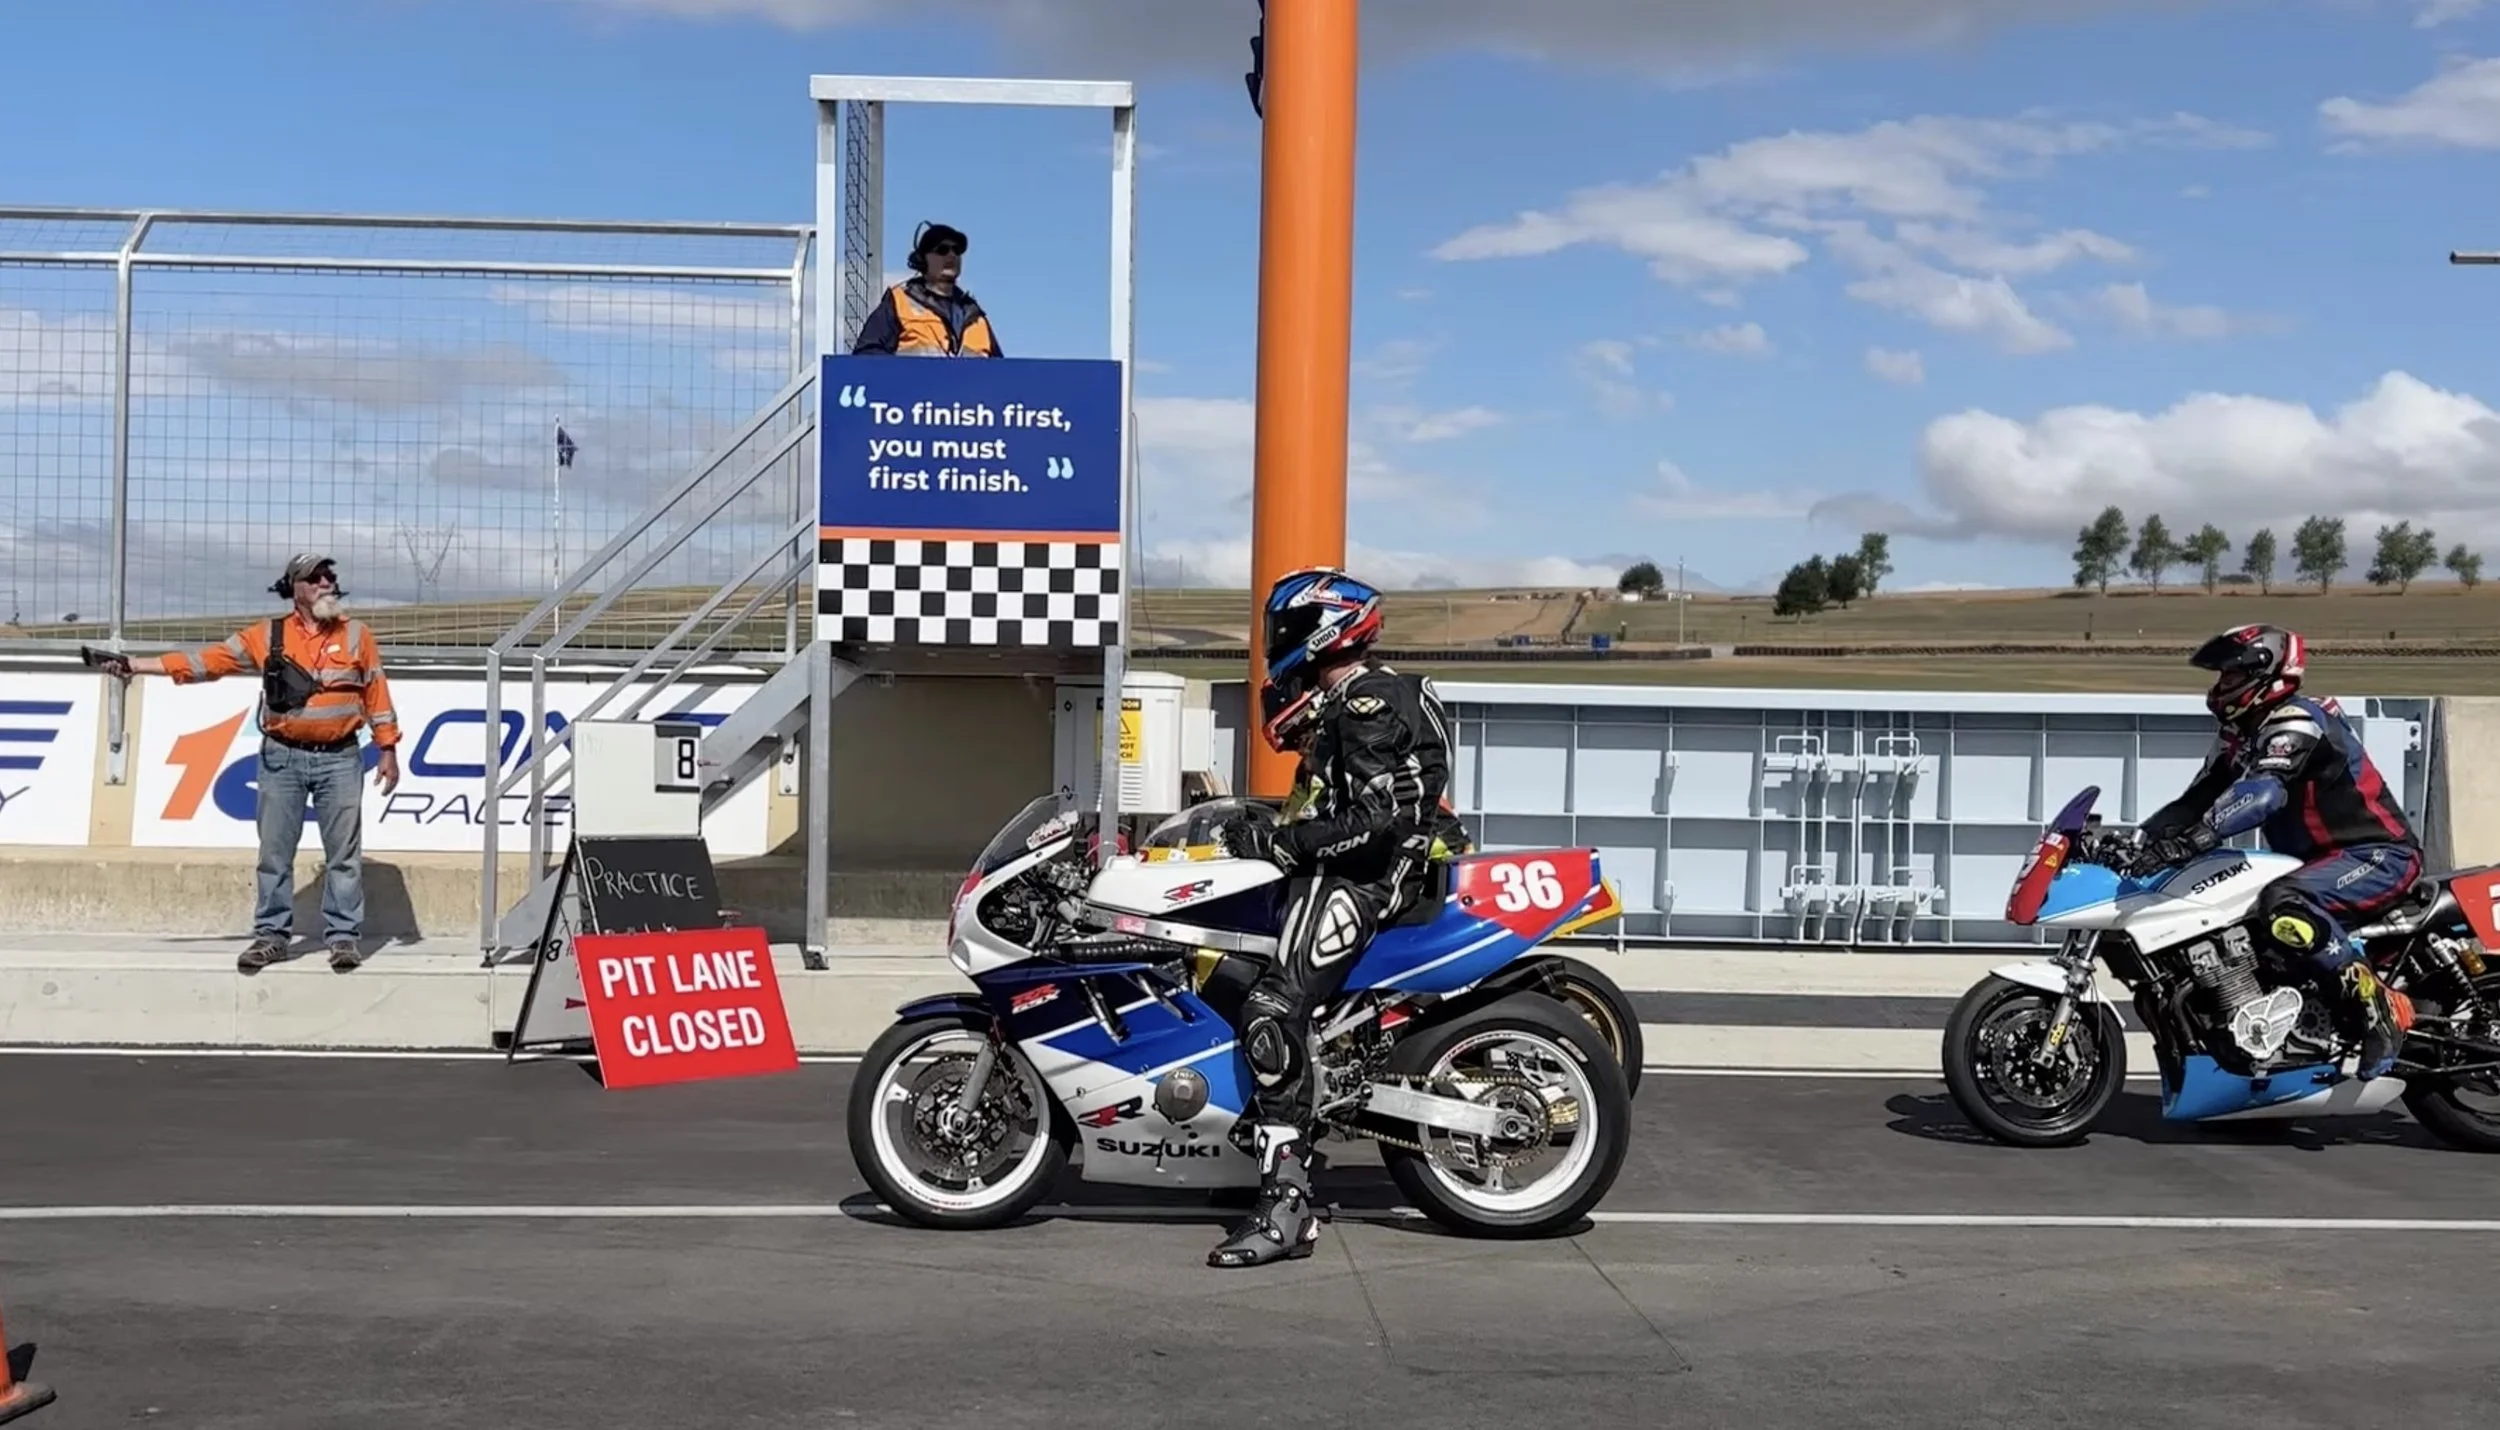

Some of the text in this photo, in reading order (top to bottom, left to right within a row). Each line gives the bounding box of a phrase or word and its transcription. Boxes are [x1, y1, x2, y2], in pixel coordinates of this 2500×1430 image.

[911, 401, 994, 427] finish
[1002, 404, 1071, 432] first,
[868, 439, 1006, 462] you must
[868, 466, 930, 490] first
[937, 468, 1029, 493] finish.
[677, 739, 695, 779] 8
[1316, 831, 1371, 858] IXON
[585, 857, 703, 900] PRACTICE
[1490, 860, 1564, 913] 36
[2190, 861, 2254, 895] SUZUKI
[598, 951, 762, 998] PIT LANE
[622, 1007, 765, 1058] CLOSED
[1096, 1138, 1221, 1158] SUZUKI
